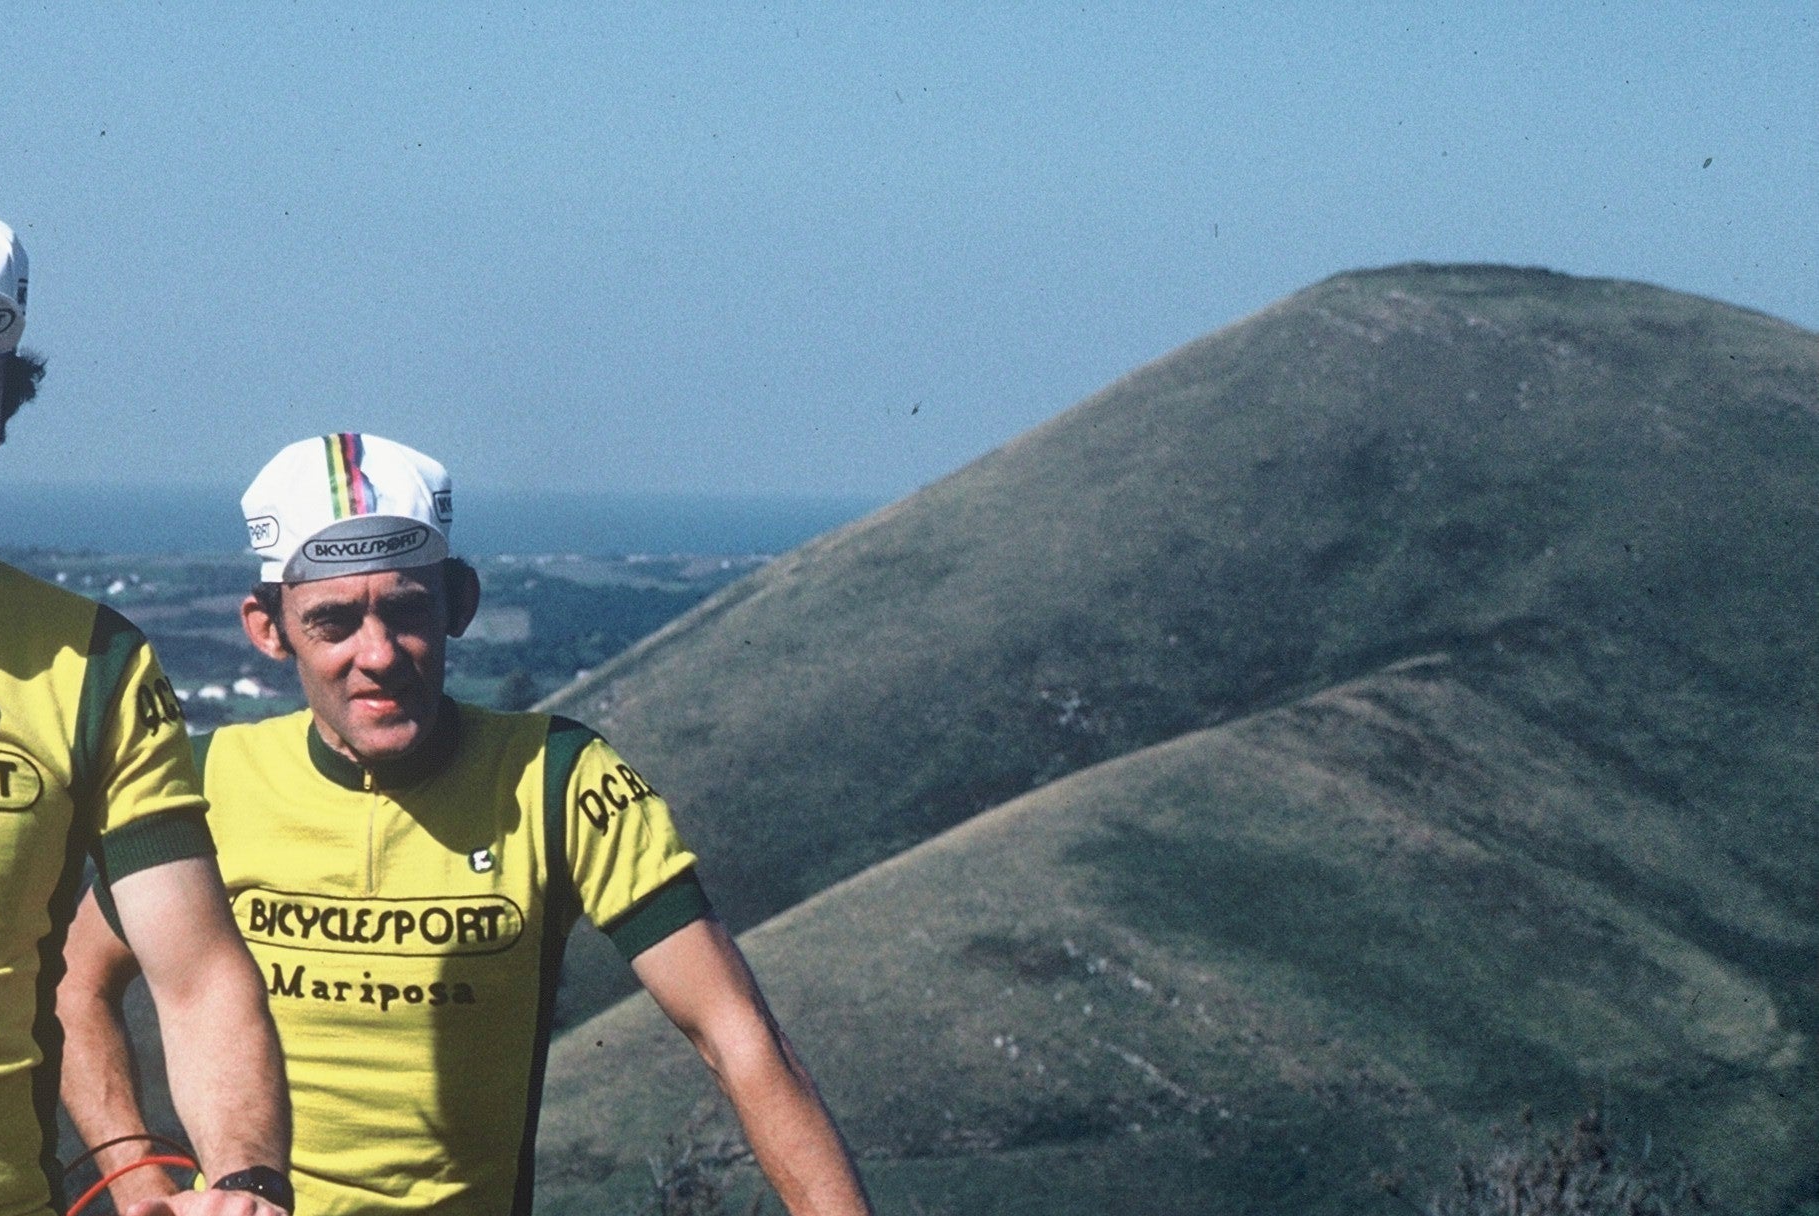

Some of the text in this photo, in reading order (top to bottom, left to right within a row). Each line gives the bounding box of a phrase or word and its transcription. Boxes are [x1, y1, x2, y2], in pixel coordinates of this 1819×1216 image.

[315, 531, 419, 557] BICYCLESPORT
[249, 898, 505, 944] BICYCLESPORT
[268, 962, 475, 1012] Mariposa
